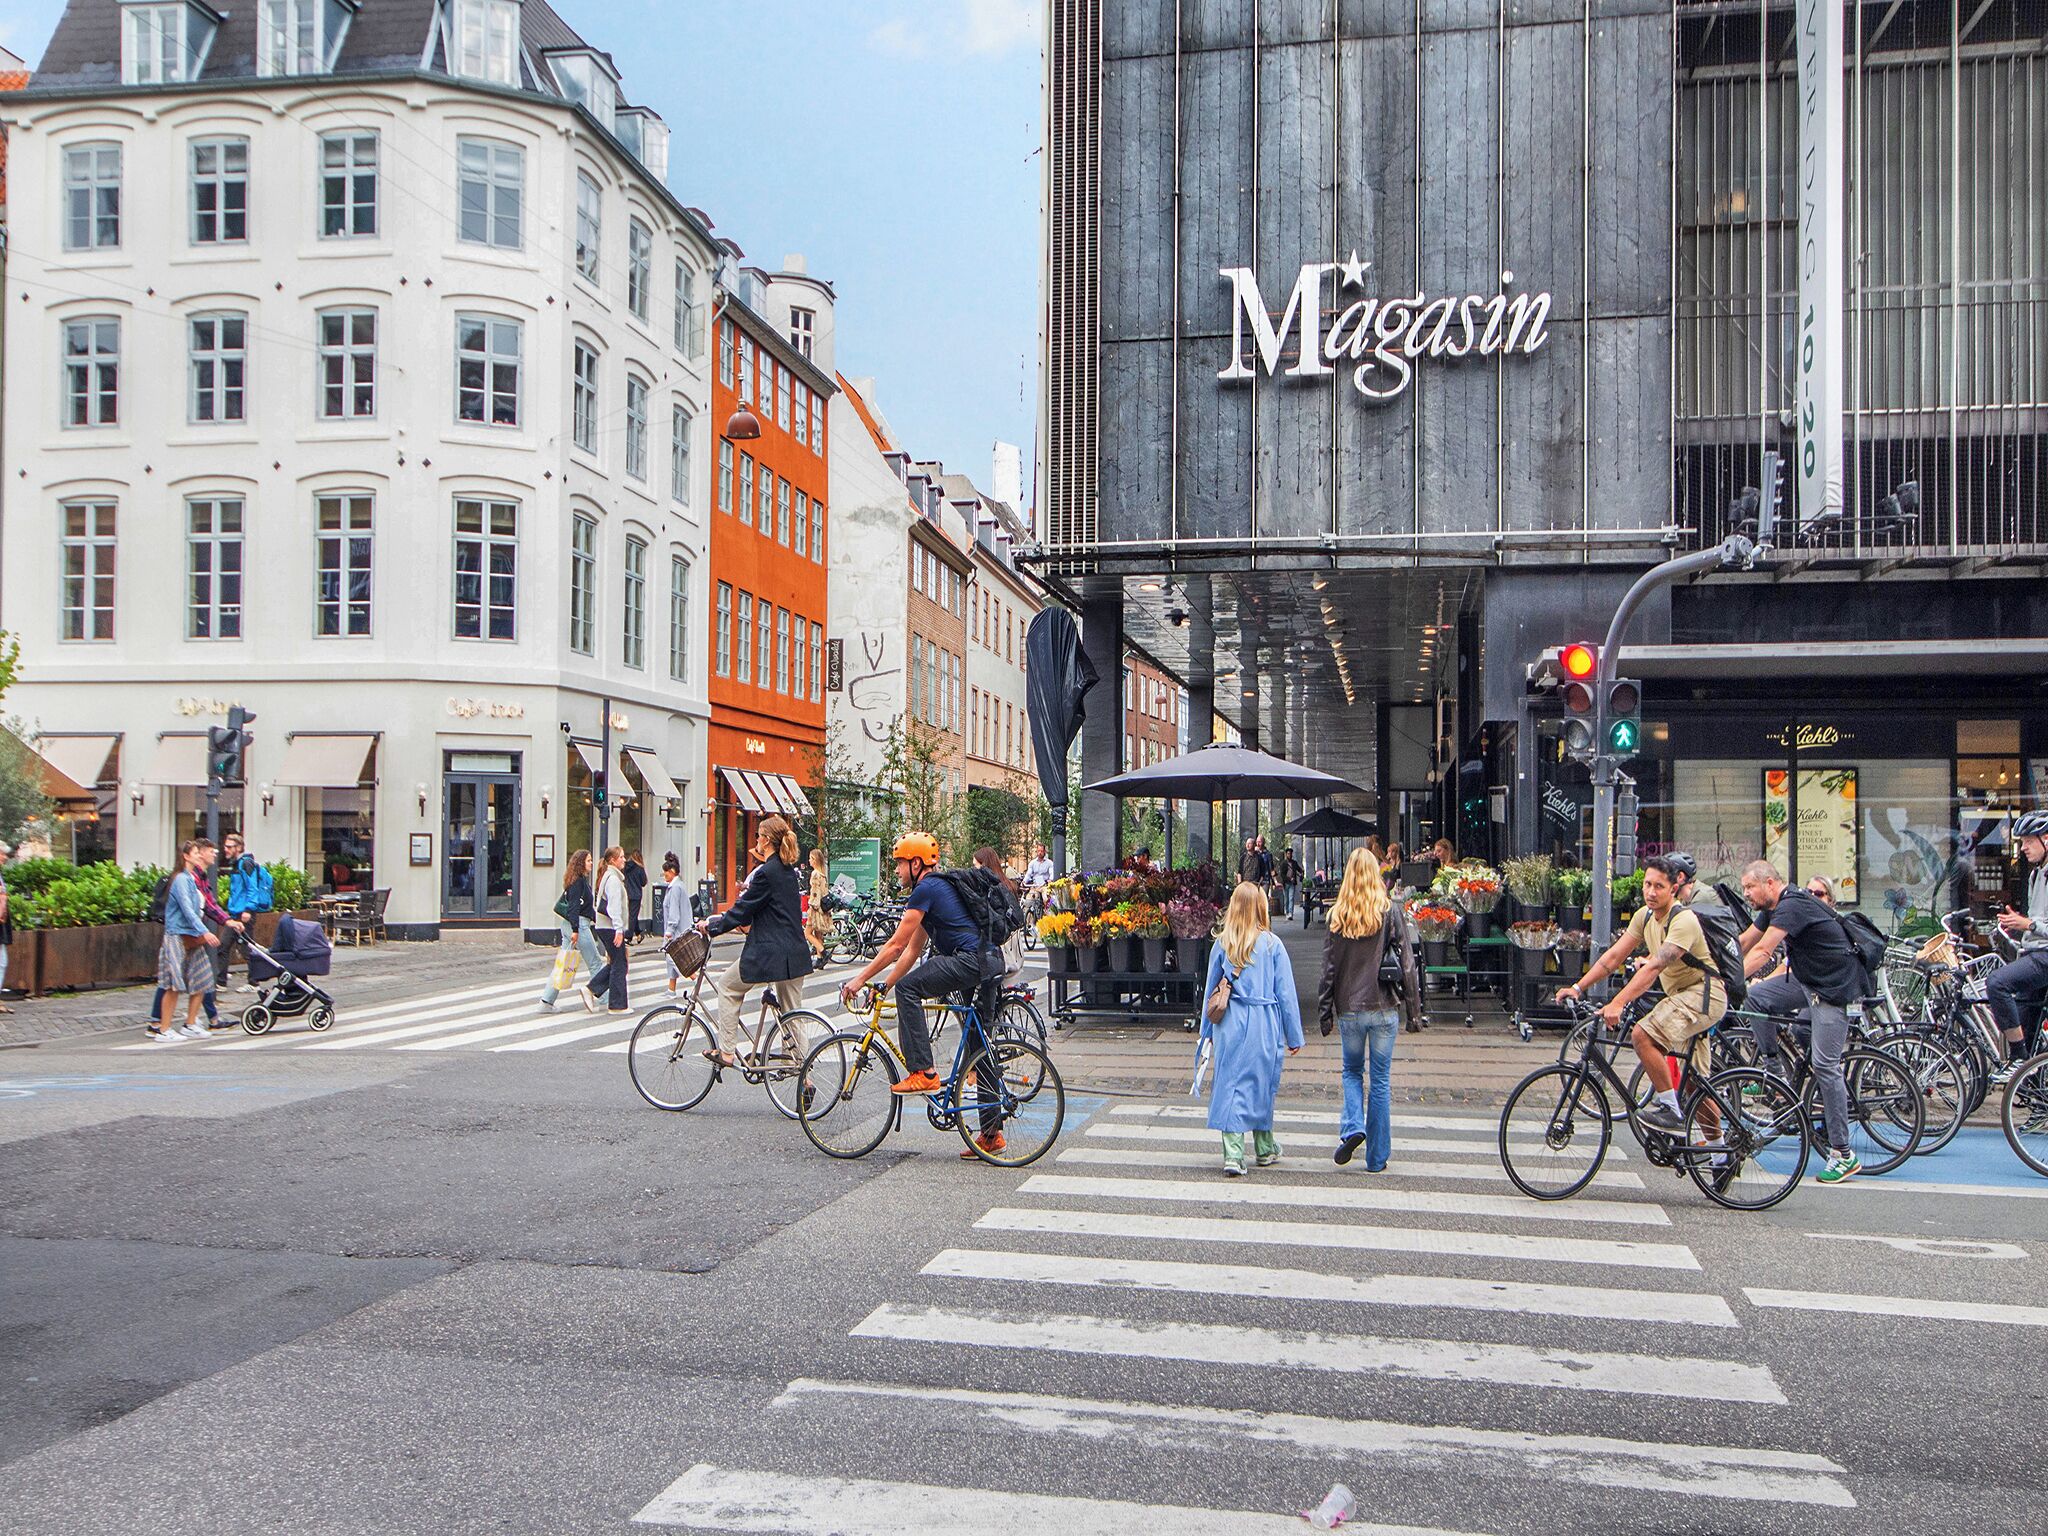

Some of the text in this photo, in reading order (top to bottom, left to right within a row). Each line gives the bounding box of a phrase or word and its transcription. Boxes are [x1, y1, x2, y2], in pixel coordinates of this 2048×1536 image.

[1802, 0, 1818, 480] VER DAG 10-20
[1217, 249, 1551, 398] Magasin
[1542, 780, 1577, 822] Kiehl's
